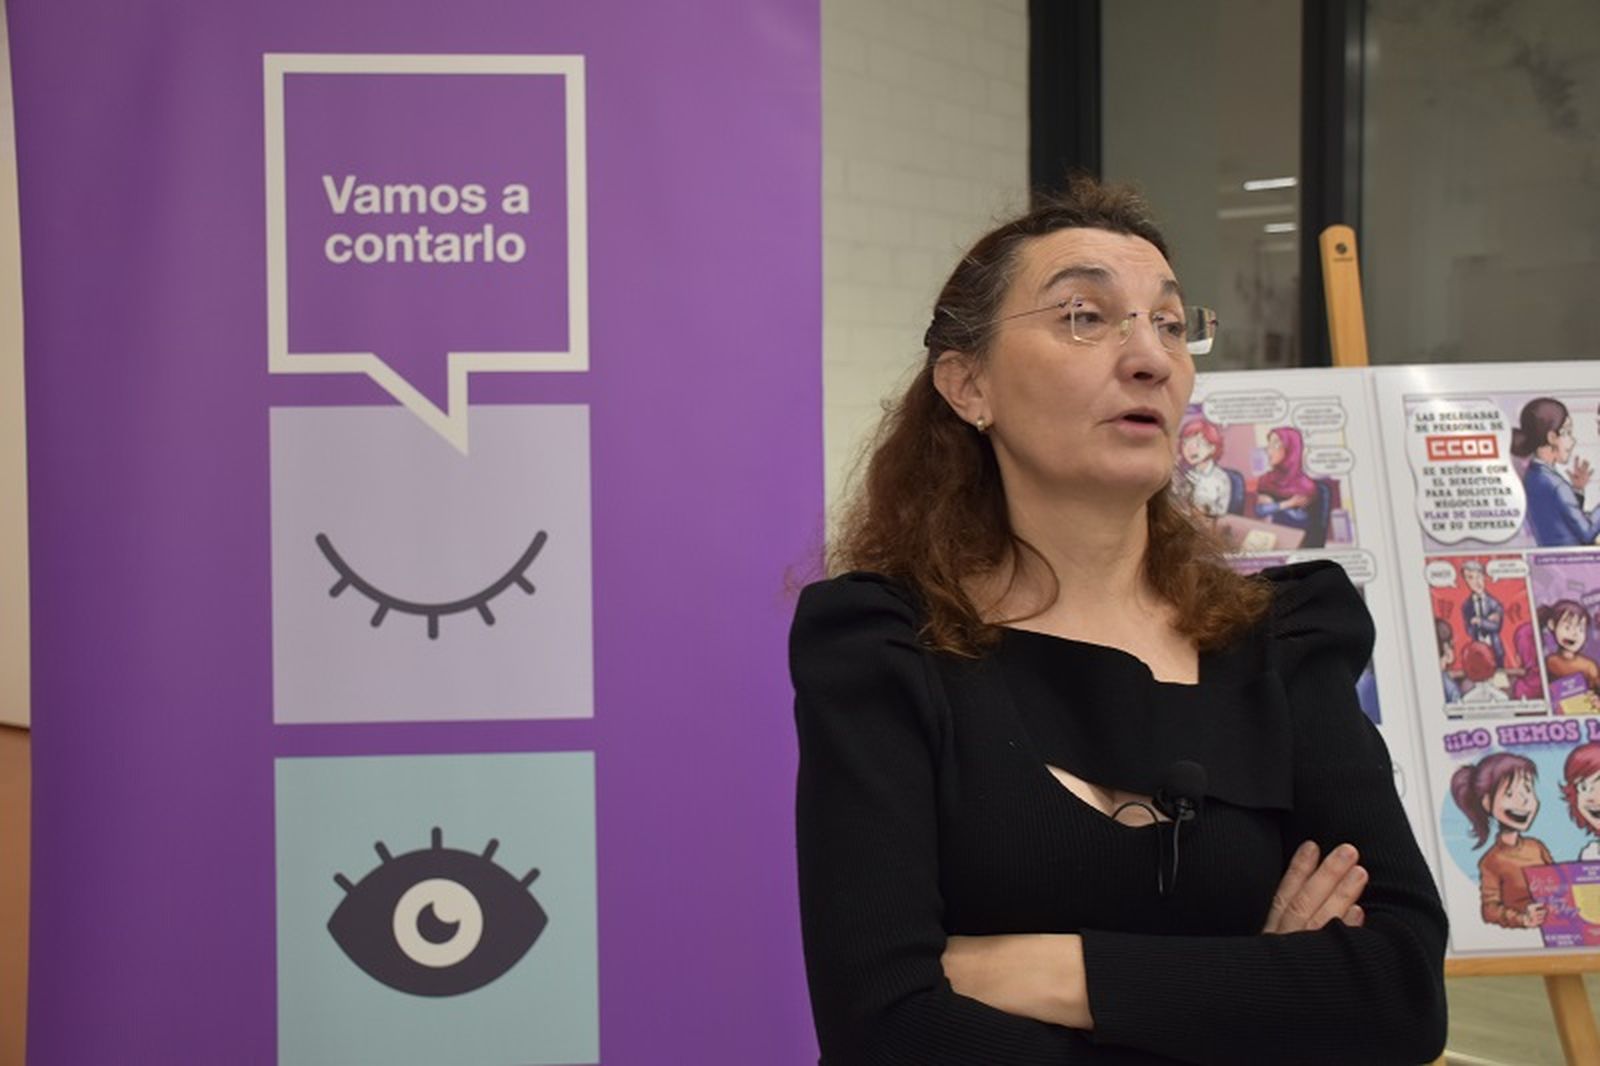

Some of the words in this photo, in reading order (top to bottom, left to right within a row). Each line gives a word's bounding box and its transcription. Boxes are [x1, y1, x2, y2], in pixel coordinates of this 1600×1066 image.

[322, 175, 487, 214] Vamos
[502, 184, 530, 214] a
[325, 224, 526, 263] contarlo
[1416, 412, 1435, 422] LAS
[1439, 411, 1499, 420] DELEGADAS
[1415, 424, 1429, 432] DE
[1433, 422, 1486, 431] PERSONAL
[1491, 422, 1503, 430] DE
[1430, 438, 1496, 458] CCOO
[1423, 467, 1436, 475] SE
[1440, 465, 1482, 474] REÚNEN
[1487, 465, 1507, 473] CON
[1433, 478, 1445, 486] EL
[1450, 477, 1502, 485] DIRECTOR
[1426, 489, 1452, 497] PARA
[1457, 487, 1512, 496] SOLICITAR
[1434, 499, 1489, 507] NEGOCIAR
[1494, 499, 1506, 507] EL
[1424, 511, 1449, 519] PLAN
[1470, 509, 1520, 517] IGUALDAD
[1432, 522, 1445, 530] EN
[1469, 521, 1516, 529] EMPRESA
[1498, 719, 1580, 745] HEMOS
